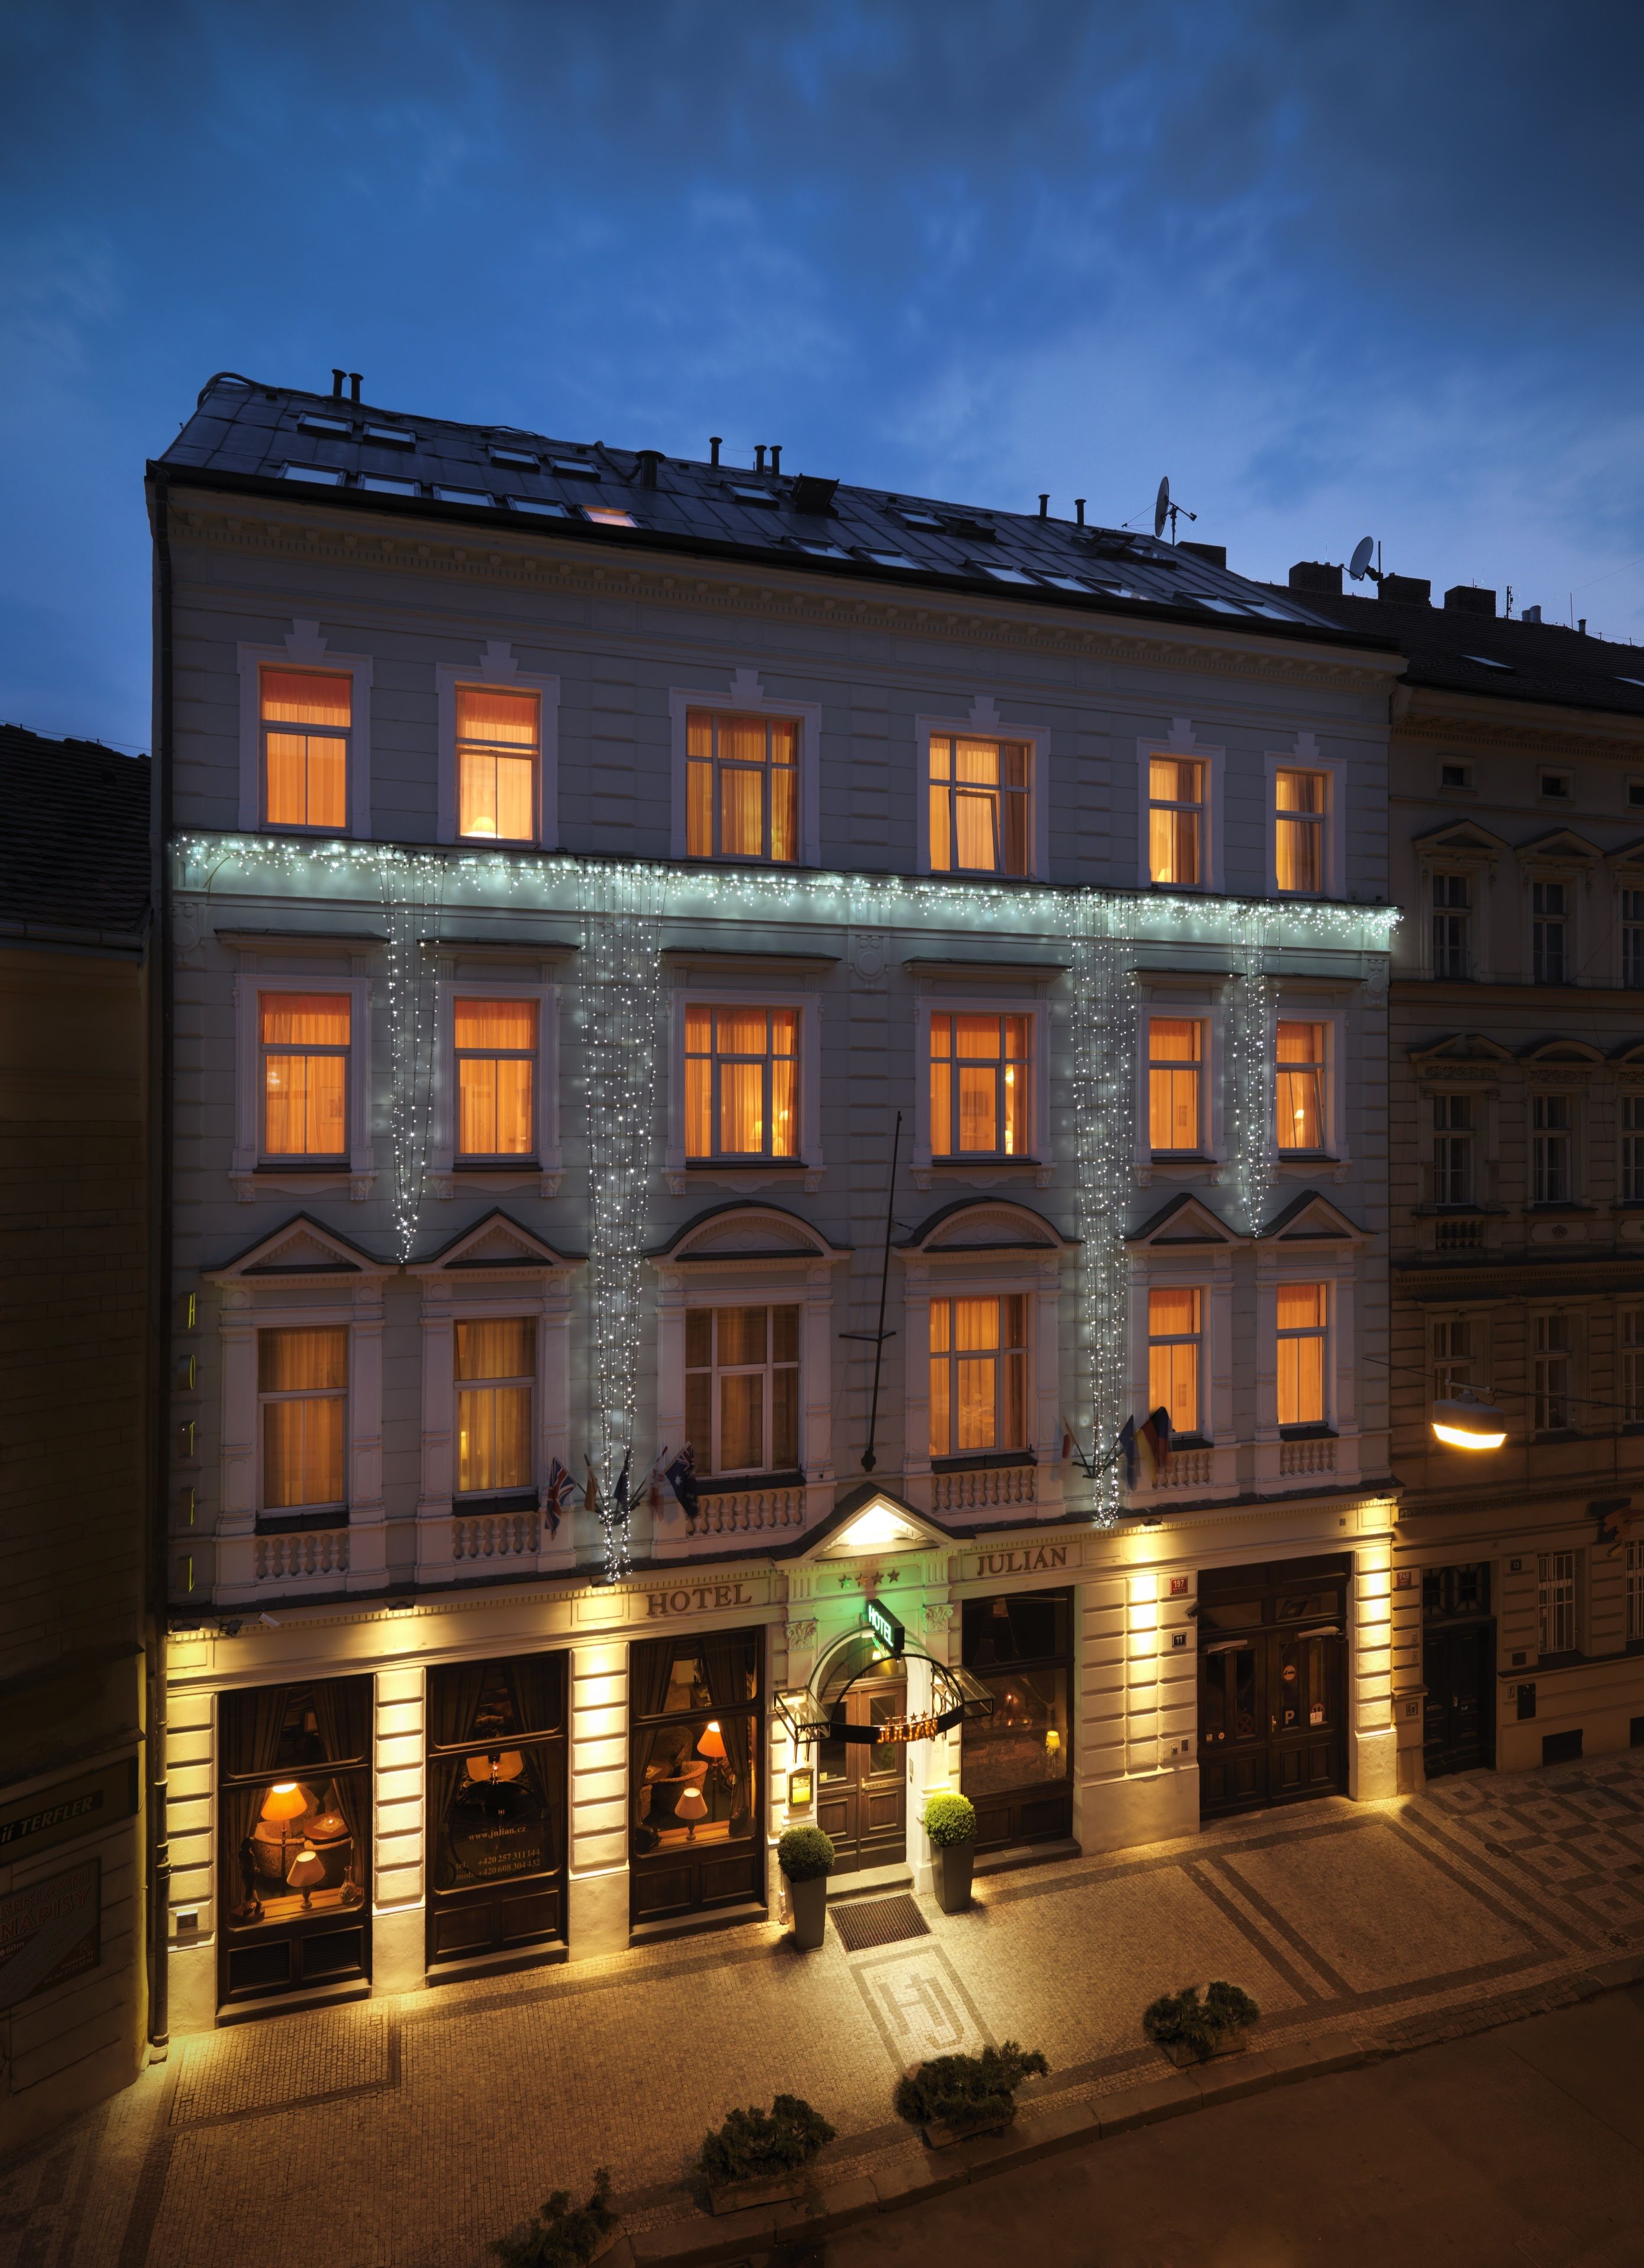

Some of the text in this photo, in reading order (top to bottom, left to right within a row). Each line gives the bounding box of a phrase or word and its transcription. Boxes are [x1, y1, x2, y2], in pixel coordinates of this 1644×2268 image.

[977, 1546, 1067, 1576] JULIÁN
[1173, 1579, 1185, 1588] 197
[646, 1583, 752, 1616] HOTEL
[869, 1604, 893, 1647] HOTEL
[1285, 1710, 1294, 1725] P
[21, 1796, 93, 1836] TERFLER
[468, 1825, 526, 1840] www.julian.cz
[478, 1856, 497, 1866] +420
[497, 1853, 511, 1862] 257
[513, 1850, 525, 1860] 311
[527, 1848, 540, 1857] 144
[478, 1868, 497, 1876] +420
[497, 1863, 511, 1872] 608
[513, 1862, 526, 1871] 304
[527, 1859, 540, 1868] 432
[0, 1866, 90, 1919] REKLAMNÍ
[0, 1886, 92, 1943] NÁPISY
